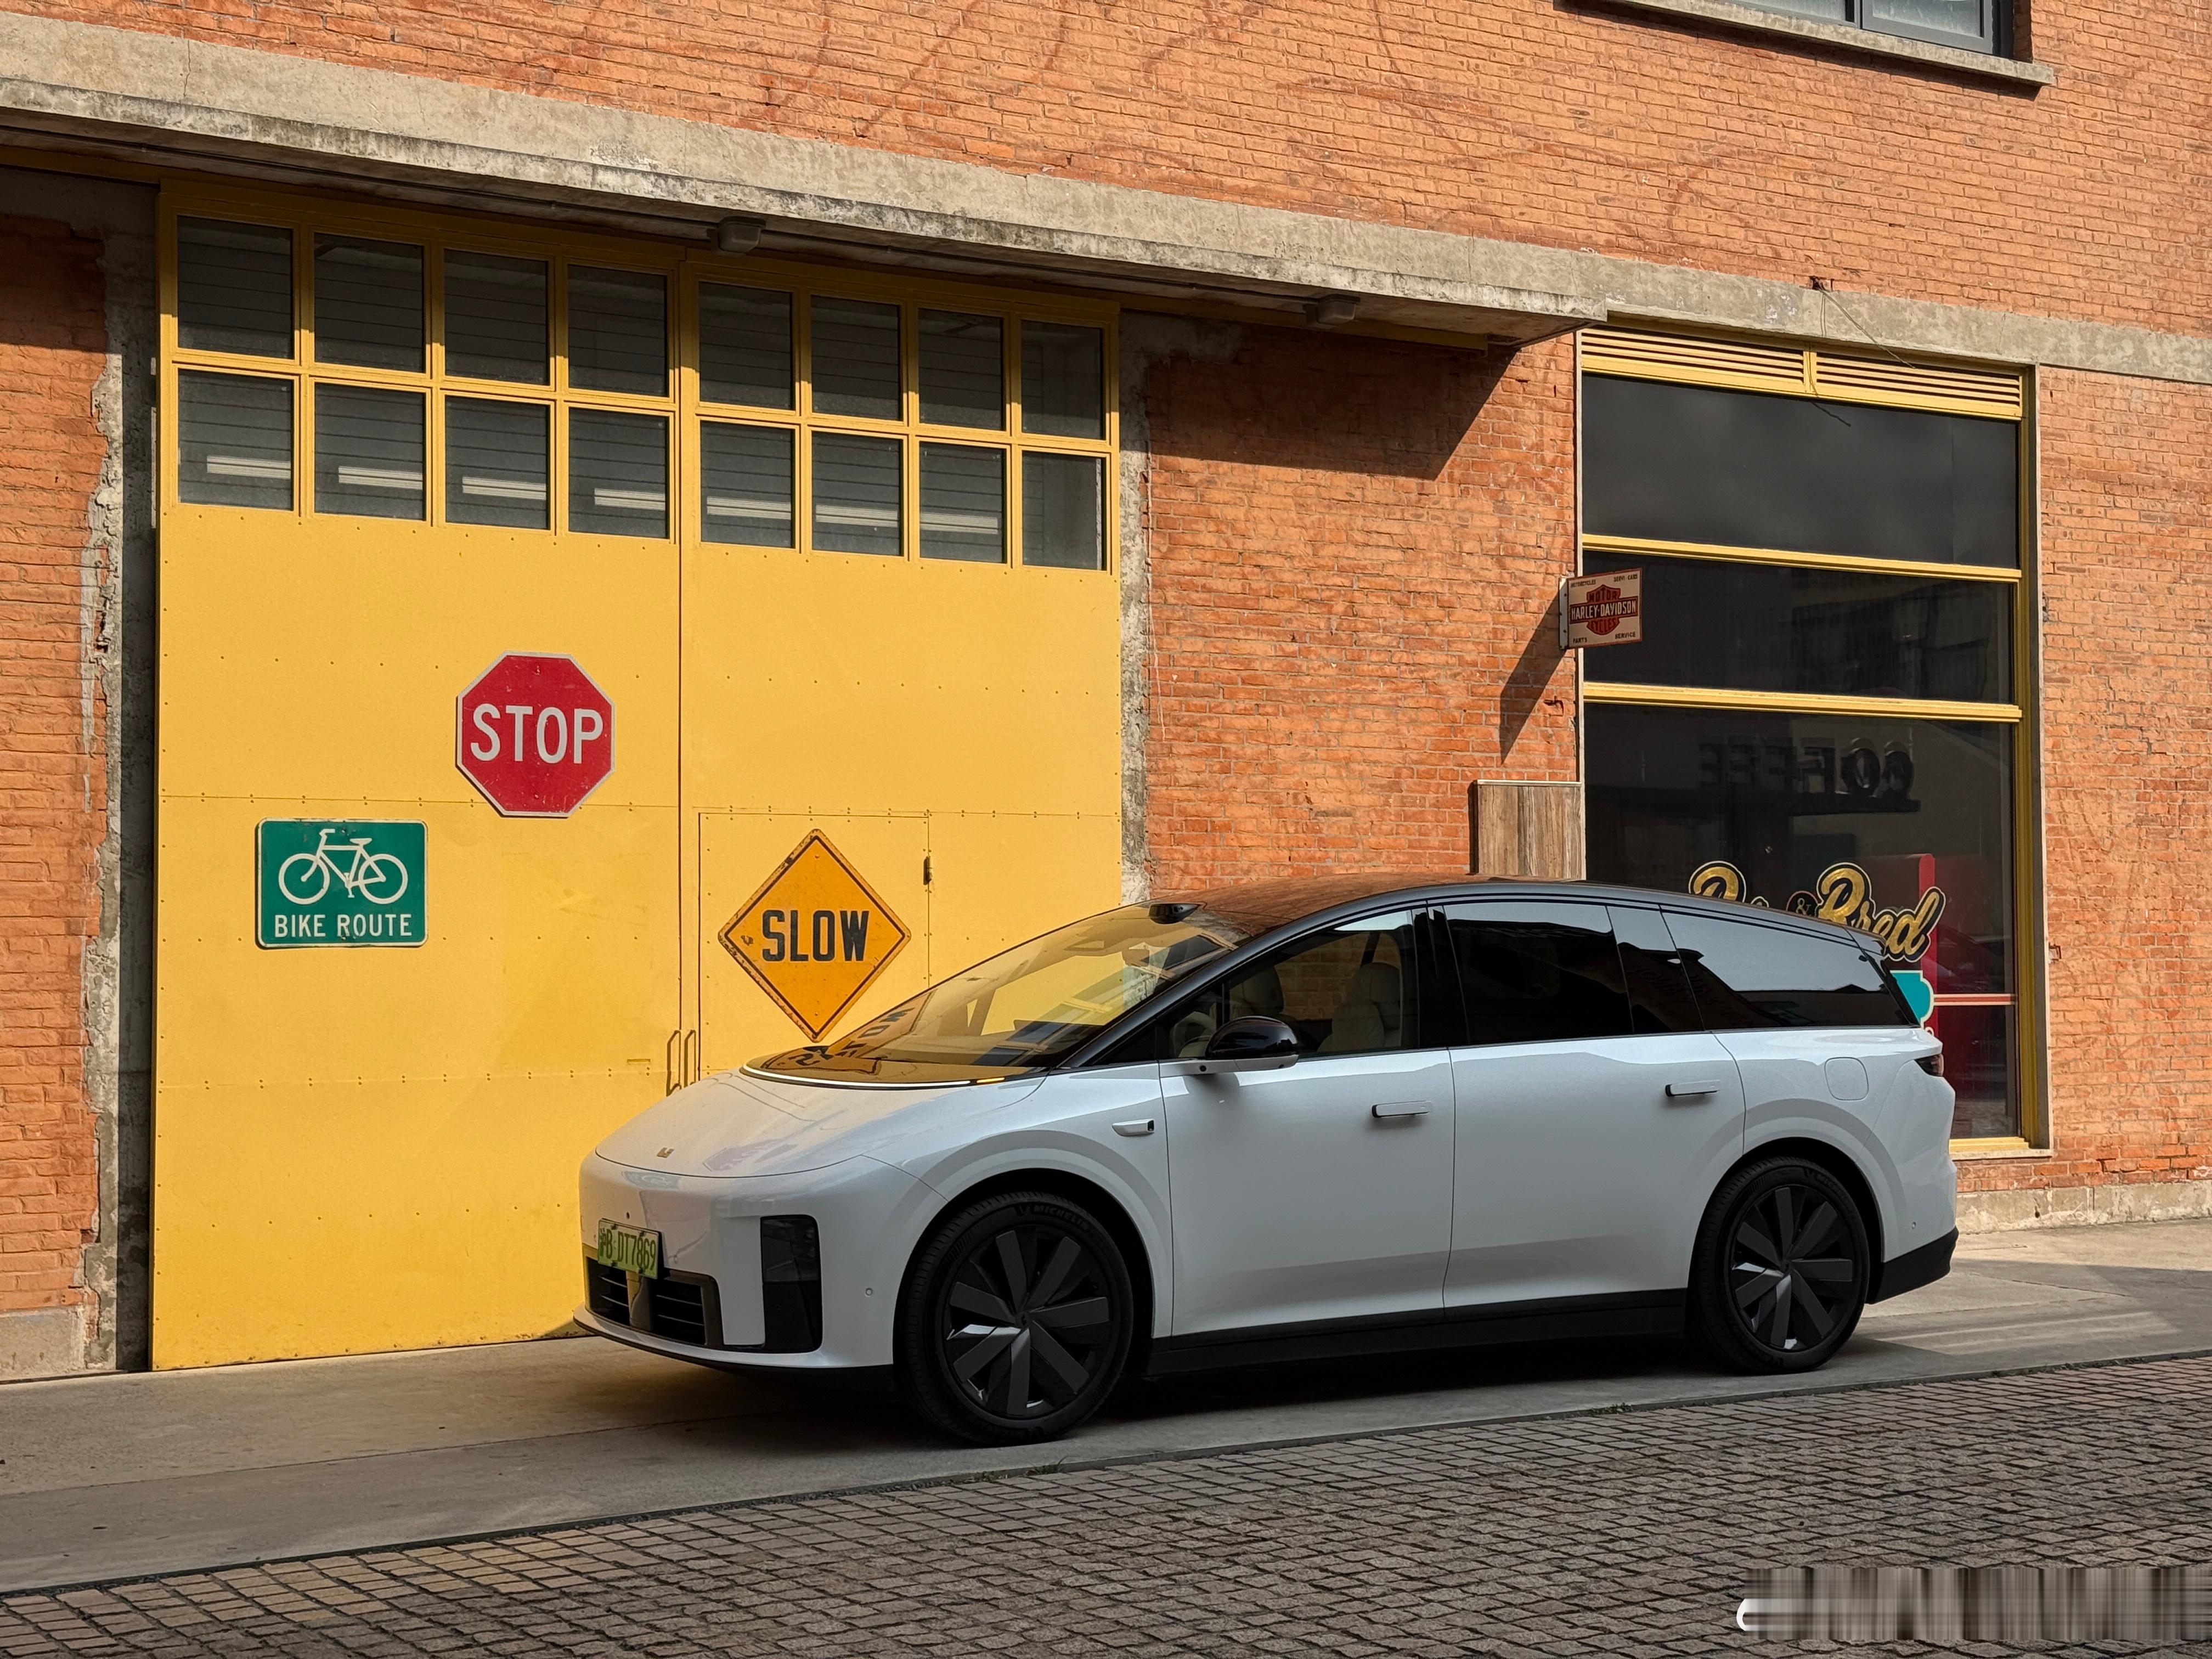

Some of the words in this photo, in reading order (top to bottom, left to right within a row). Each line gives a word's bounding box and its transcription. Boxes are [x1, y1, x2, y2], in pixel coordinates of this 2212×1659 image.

[1588, 587, 1617, 602] MOTOR
[1591, 619, 1616, 632] CYCLES
[1615, 631, 1636, 640] SERVICE
[470, 703, 603, 764] STOP
[274, 915, 326, 938] BIKE
[337, 914, 412, 936] ROUTE
[761, 910, 870, 962] SLOW
